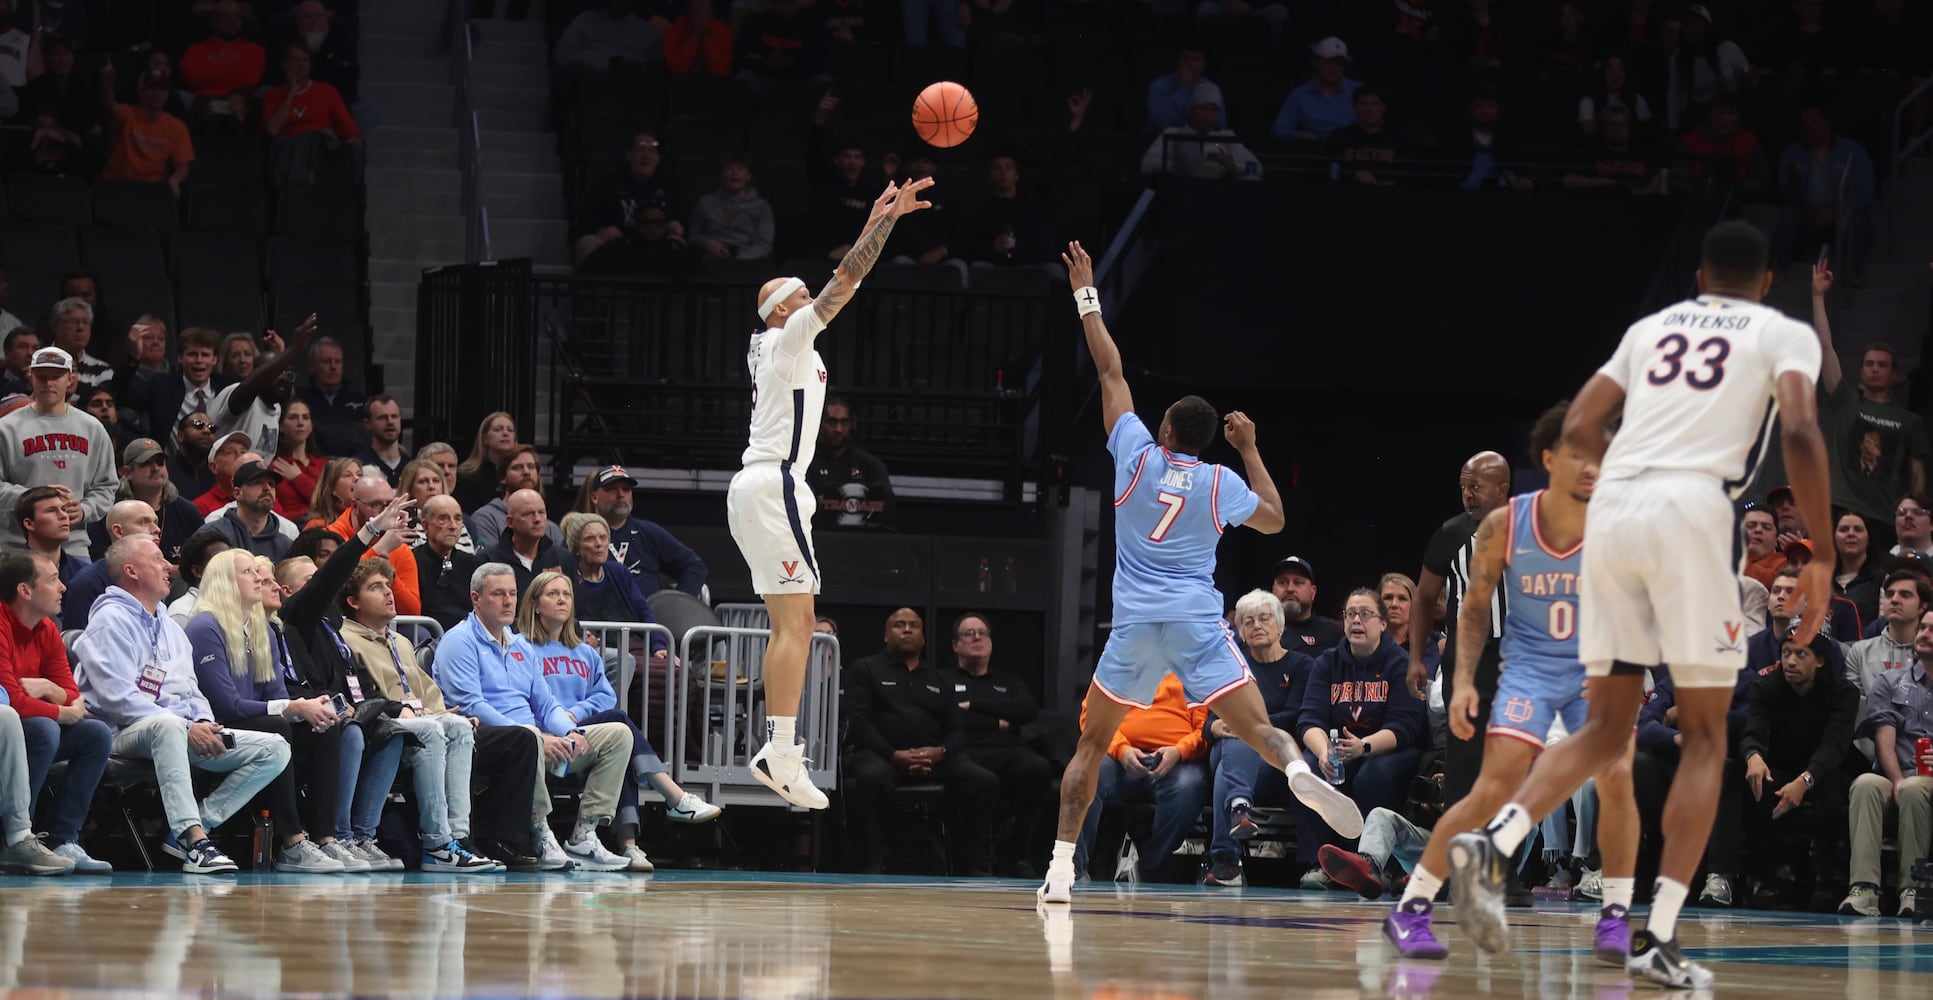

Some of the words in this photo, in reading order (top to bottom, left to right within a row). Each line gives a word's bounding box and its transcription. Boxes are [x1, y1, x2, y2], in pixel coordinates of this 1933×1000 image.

[1663, 312, 1752, 331] ONYENSO
[1648, 333, 1731, 391] 33
[23, 433, 89, 457] DAYTON
[1160, 468, 1194, 491] JONES
[1149, 490, 1186, 543] 7
[781, 560, 799, 578] V
[1520, 571, 1582, 596] DAYT
[1547, 599, 1577, 642] 0
[1724, 620, 1742, 644] V
[542, 655, 591, 679] AYTO
[140, 680, 160, 693] MEDIA
